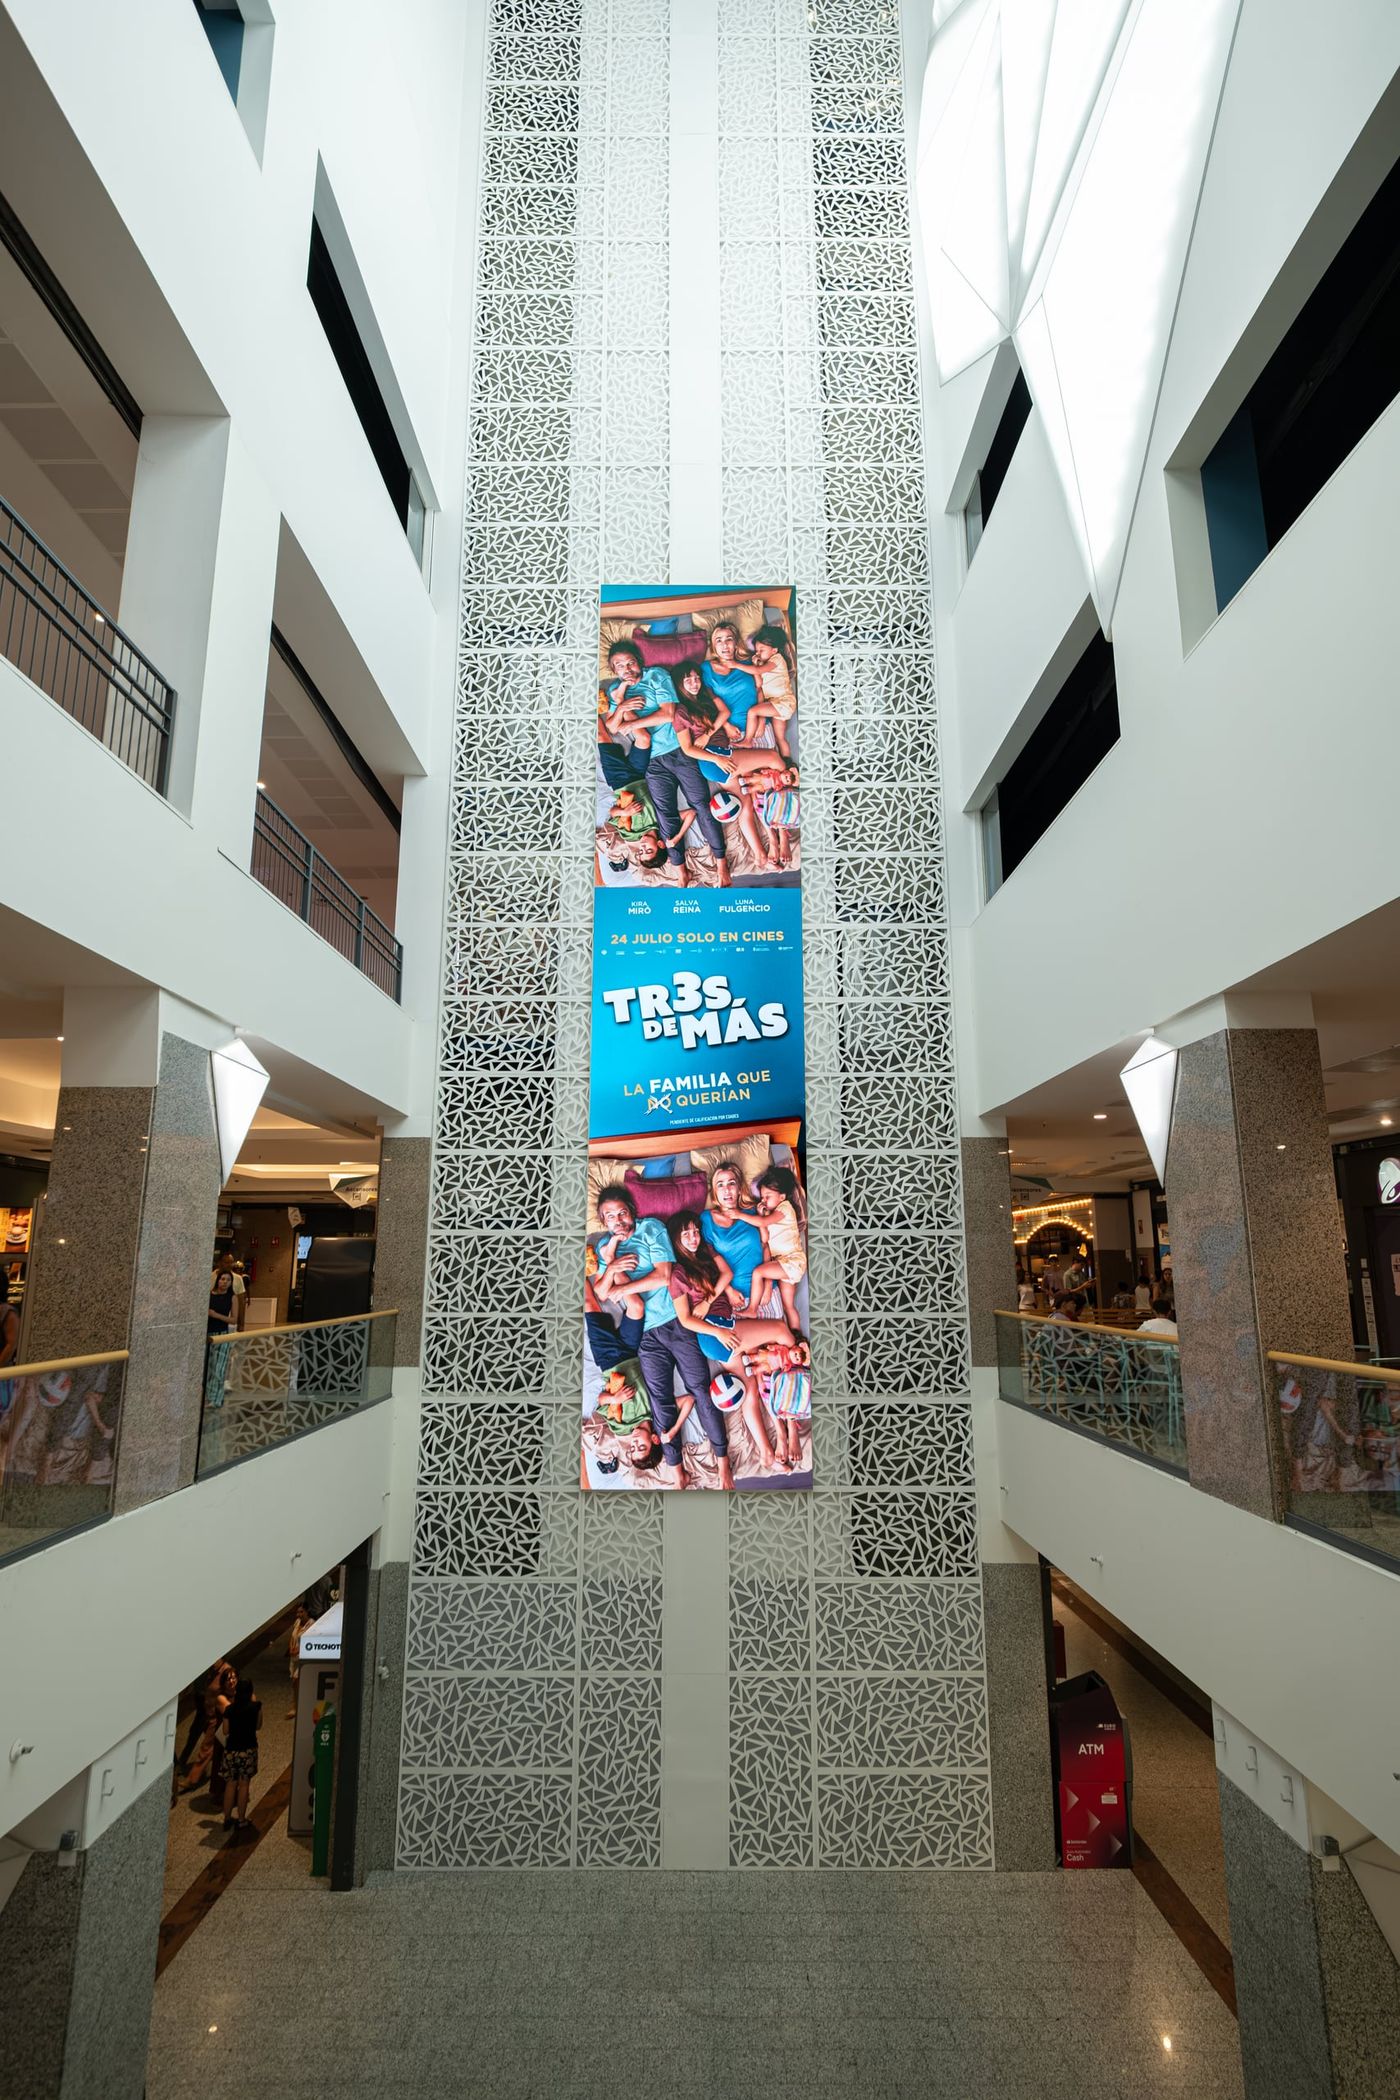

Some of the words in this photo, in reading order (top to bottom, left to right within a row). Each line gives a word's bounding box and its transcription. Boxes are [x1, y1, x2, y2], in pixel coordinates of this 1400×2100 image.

[673, 906, 701, 914] REINA
[719, 904, 771, 913] FULGENCIO
[611, 934, 627, 944] 24
[632, 933, 673, 944] JULIO
[677, 933, 715, 943] SOLO
[719, 932, 738, 942] EN
[742, 931, 784, 941] CINES
[642, 1017, 679, 1040] DE
[679, 997, 789, 1049] MÁS
[624, 1083, 645, 1097] LA
[650, 1072, 732, 1094] FAMILIA
[736, 1070, 771, 1085] QUE
[676, 1088, 751, 1107] QUERÍAN
[1078, 1743, 1105, 1756] ATM
[1066, 1853, 1085, 1862] Cash
